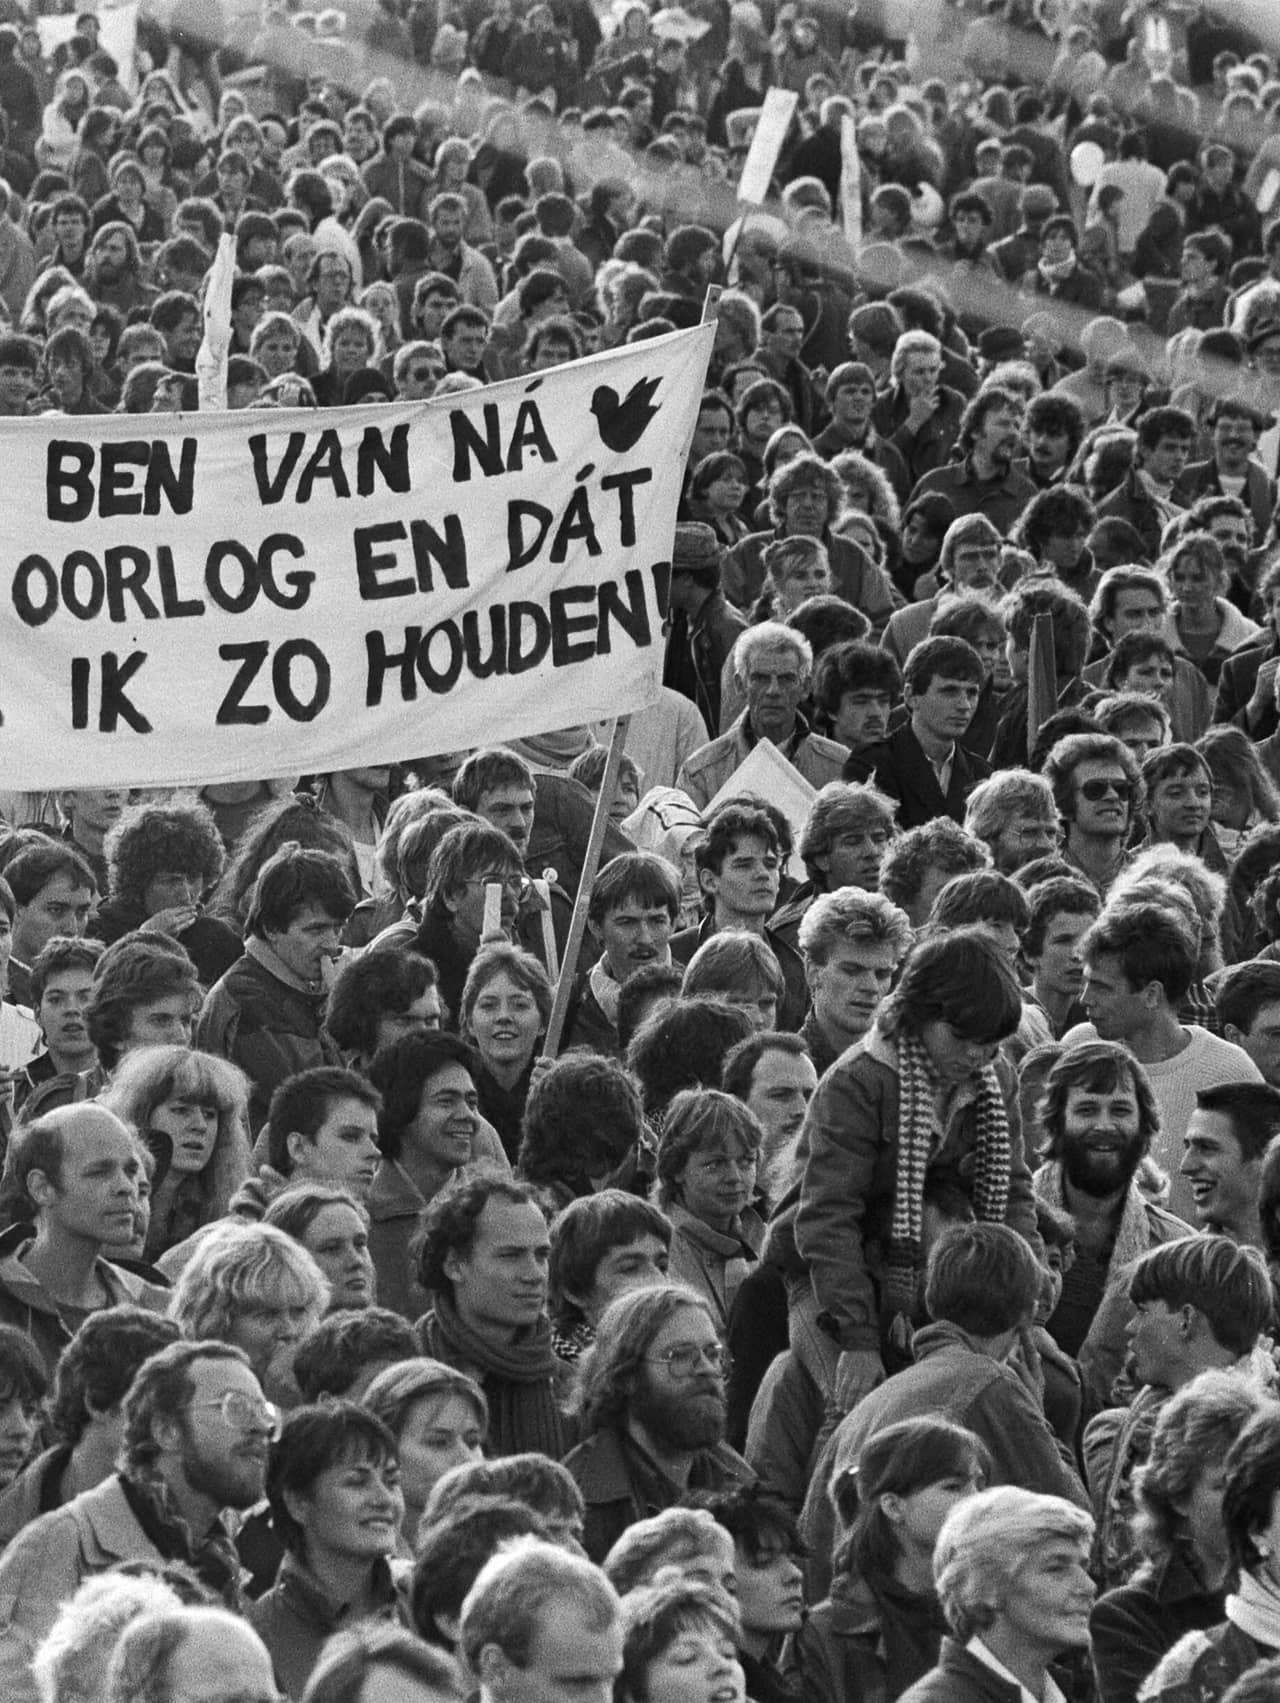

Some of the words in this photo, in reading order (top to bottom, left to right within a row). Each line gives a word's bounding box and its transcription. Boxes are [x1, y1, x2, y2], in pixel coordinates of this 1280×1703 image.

[46, 437, 198, 523] BEN
[248, 422, 411, 505] VAN
[449, 378, 558, 483] NÁ
[11, 532, 316, 628] OORLOG
[353, 513, 470, 601] EN
[505, 464, 653, 574] DÁT
[71, 650, 153, 735] IK
[216, 638, 331, 726] ZO
[364, 561, 671, 707] HOUDEN!
